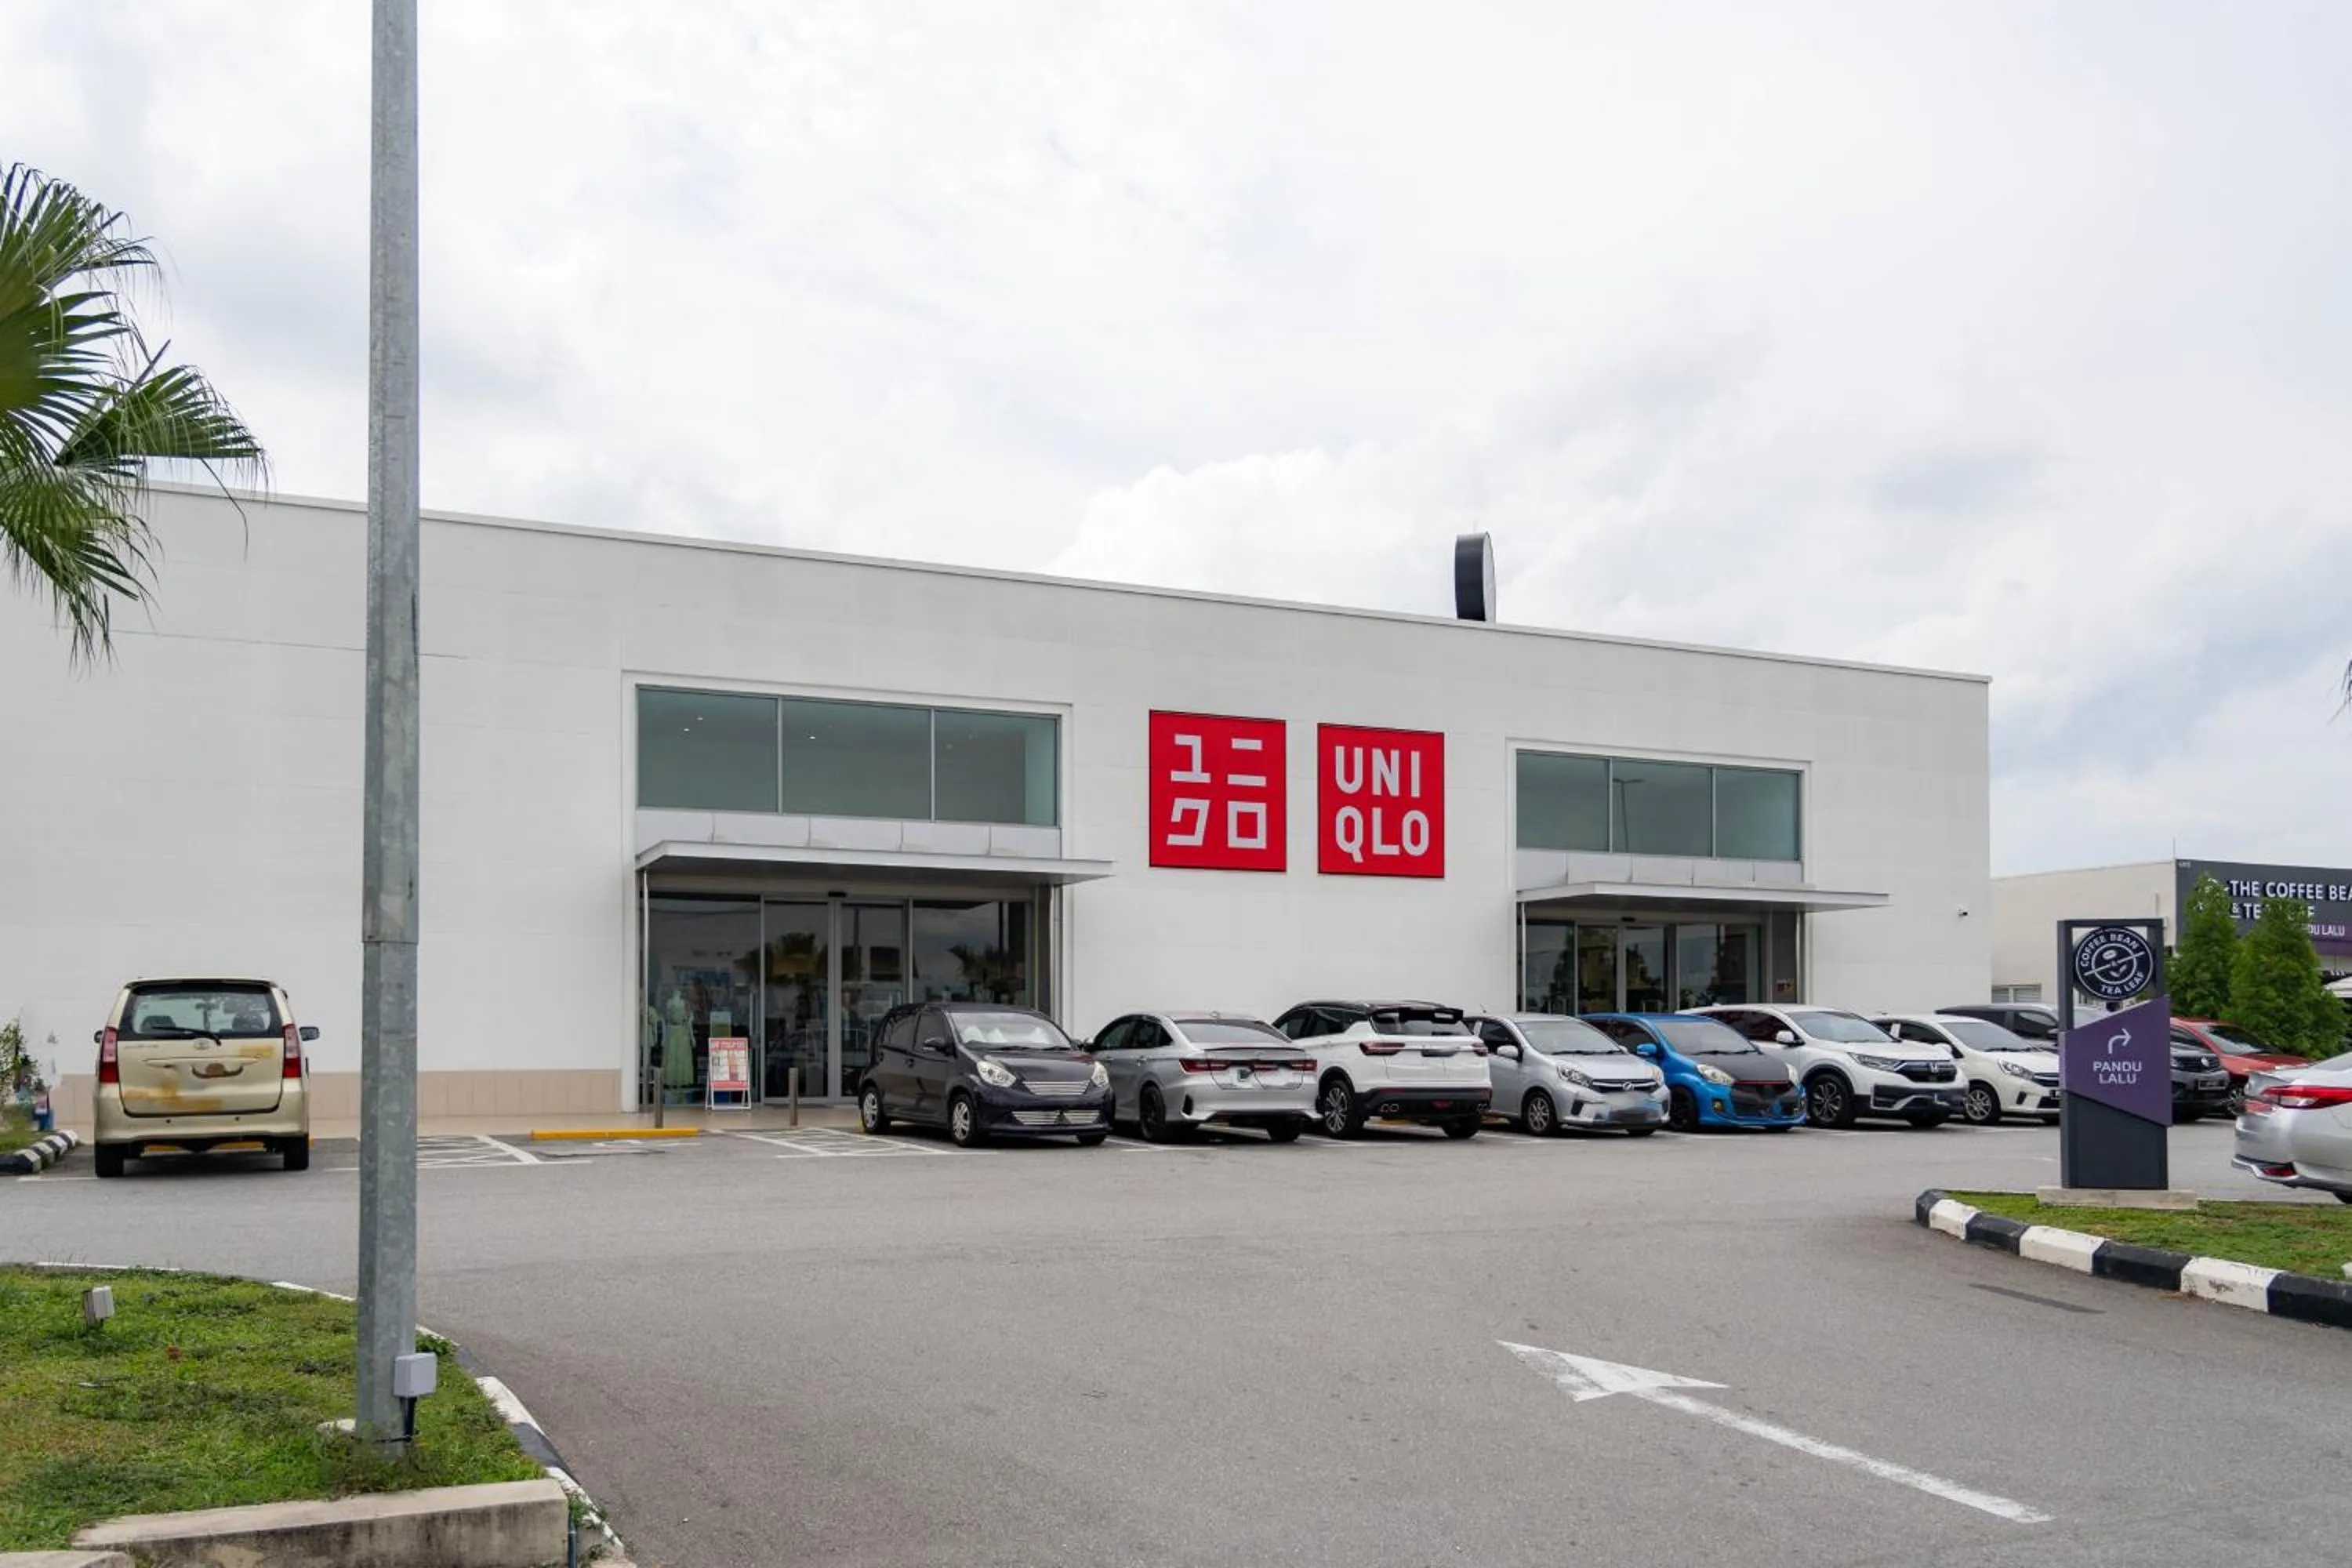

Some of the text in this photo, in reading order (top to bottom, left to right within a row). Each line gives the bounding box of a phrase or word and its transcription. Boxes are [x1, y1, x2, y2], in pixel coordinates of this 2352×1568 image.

[1335, 746, 1421, 798] UNI
[1335, 806, 1430, 862] QLO
[2230, 880, 2259, 897] THE
[2266, 882, 2324, 899] COFFEE
[2243, 902, 2270, 919] TE
[2321, 924, 2345, 936] LALU
[2080, 934, 2139, 967] COFFEE BEAN
[2101, 971, 2144, 995] TEA LEAF
[2092, 1061, 2142, 1072] PANDU
[2099, 1073, 2136, 1084] LALU
